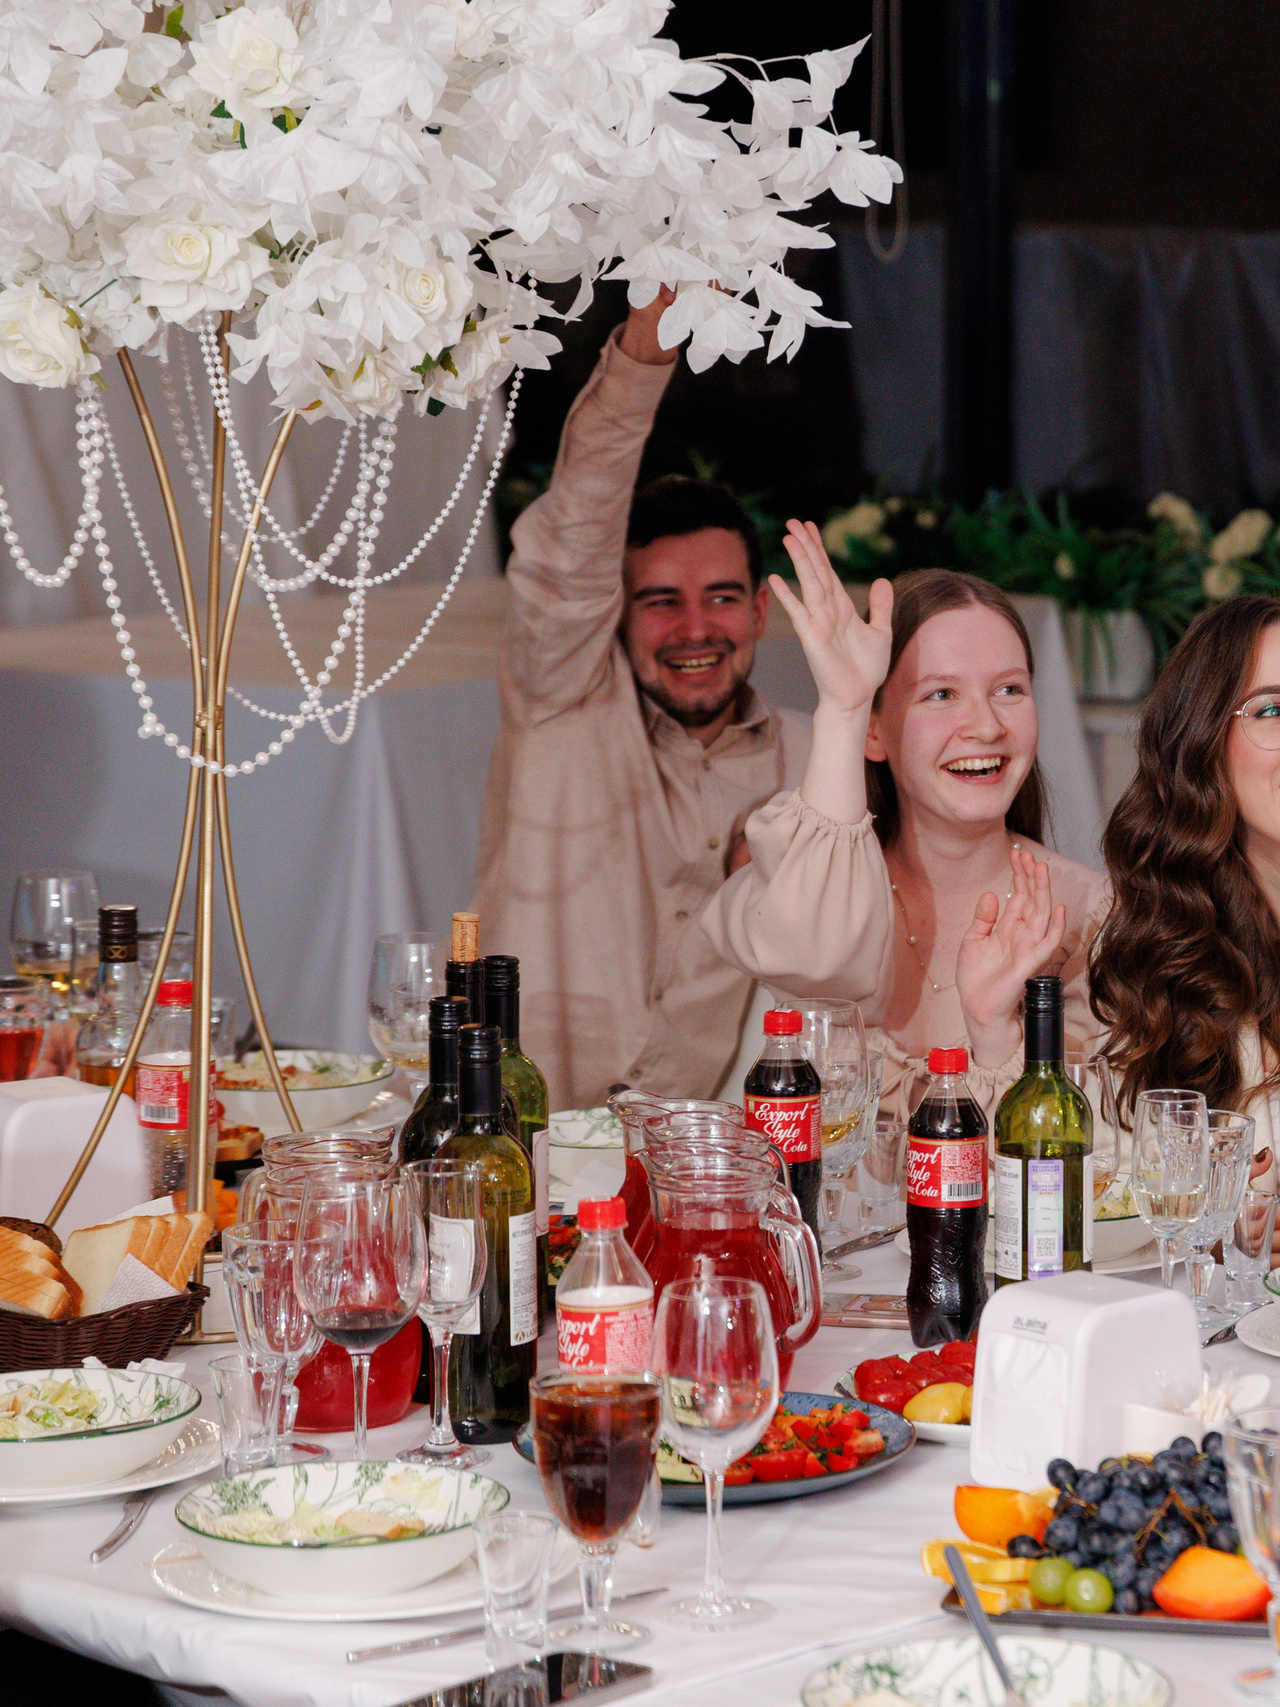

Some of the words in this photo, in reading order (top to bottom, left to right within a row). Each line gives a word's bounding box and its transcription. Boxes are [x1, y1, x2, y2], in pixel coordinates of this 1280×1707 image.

[755, 1103, 809, 1130] Export
[763, 1121, 800, 1144] Style
[782, 1138, 808, 1153] Cola
[915, 1181, 939, 1198] Cola
